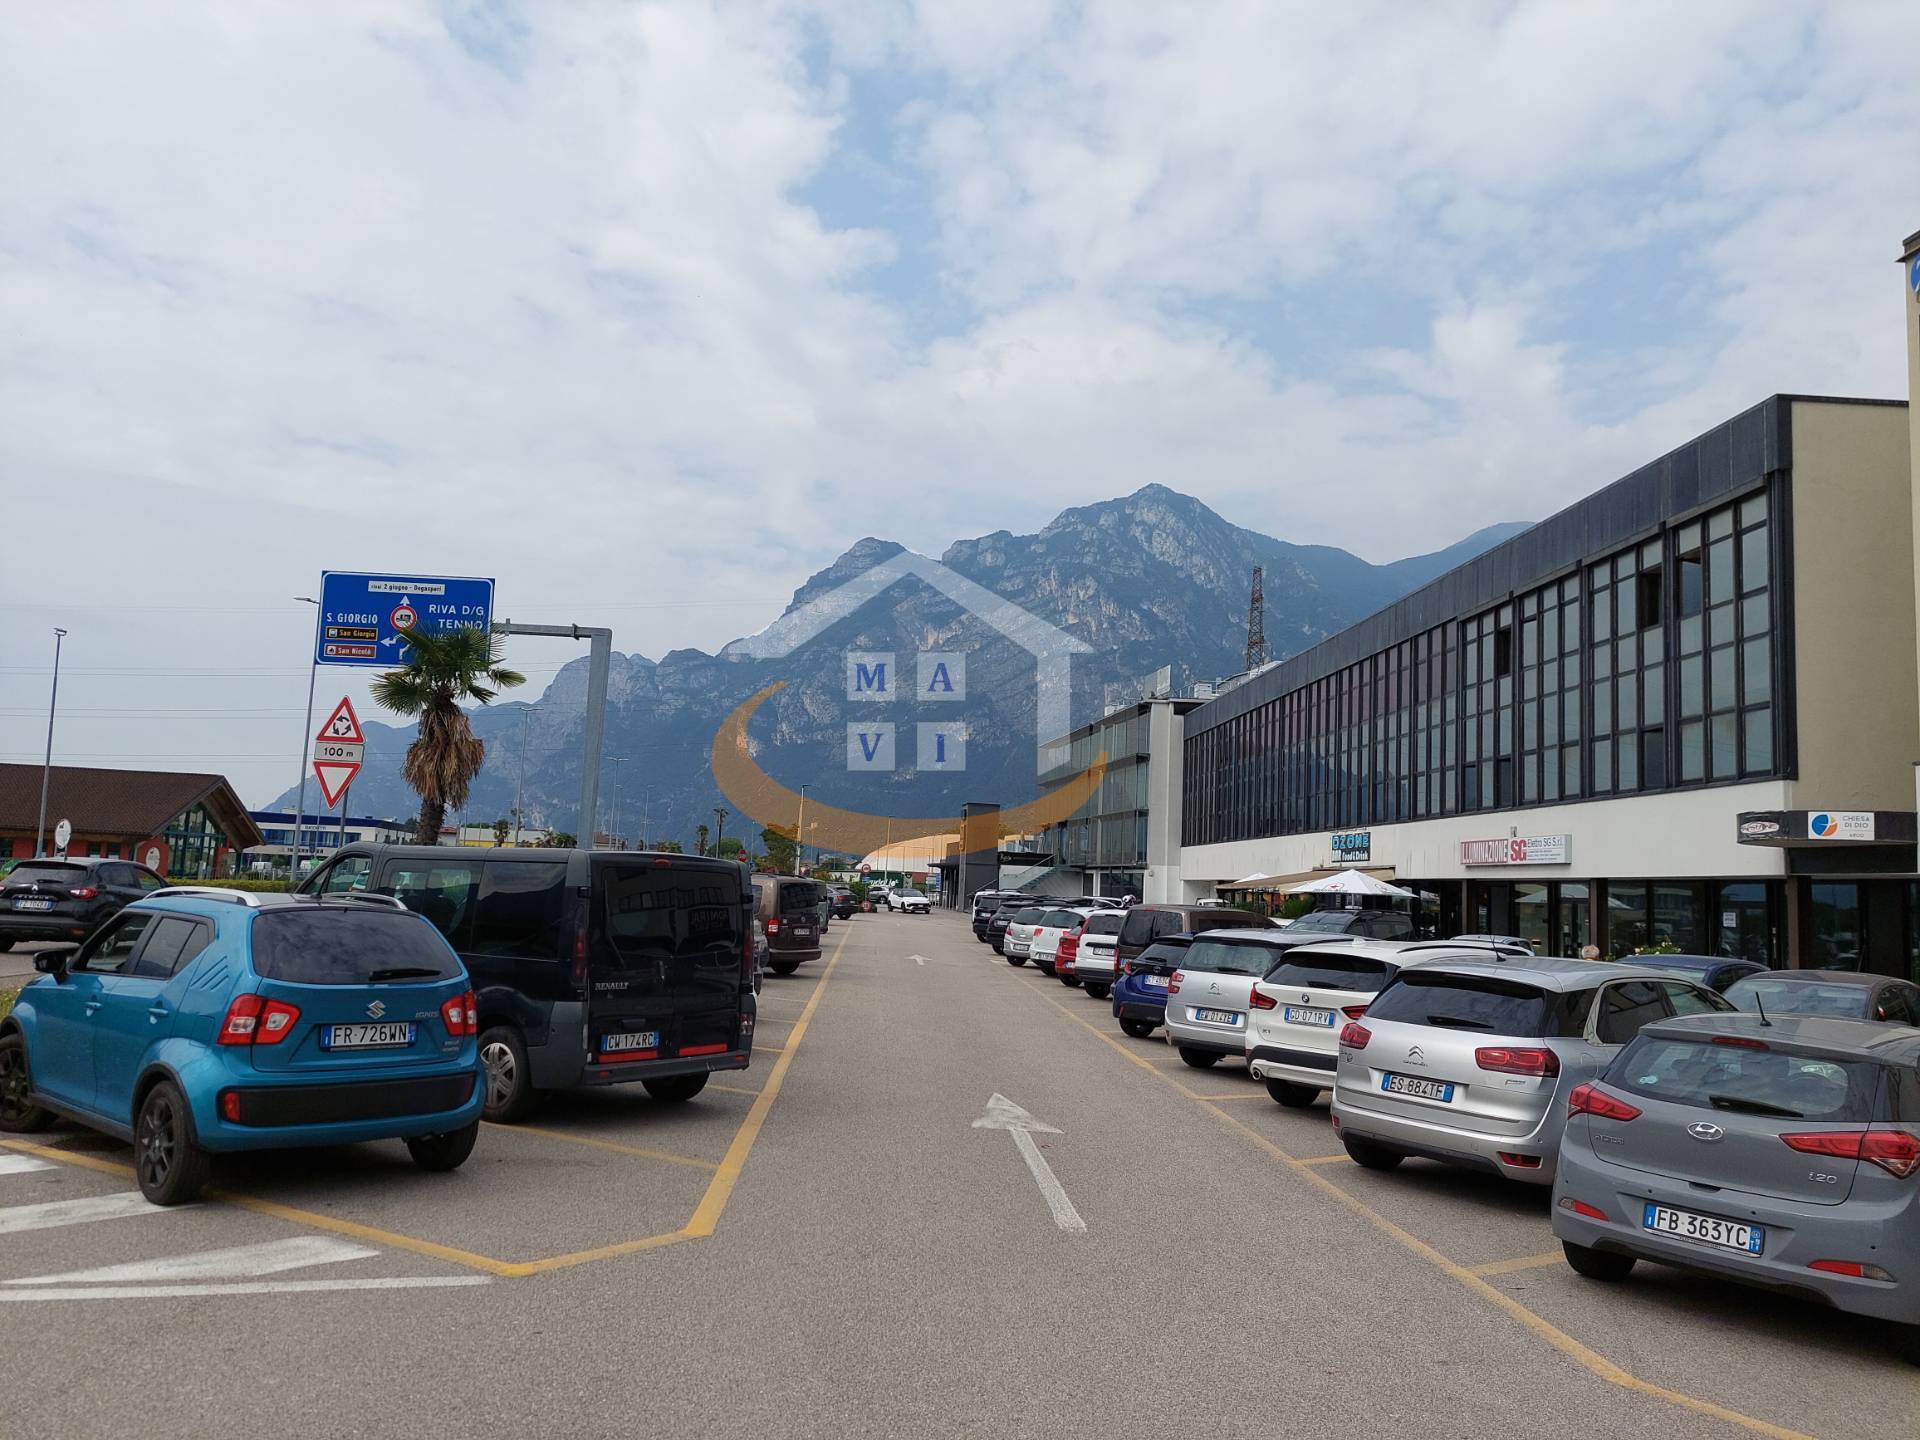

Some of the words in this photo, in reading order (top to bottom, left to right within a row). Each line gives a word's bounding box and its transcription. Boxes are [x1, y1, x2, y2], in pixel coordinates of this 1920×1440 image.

[429, 604, 456, 615] RIVA
[462, 606, 485, 616] D/G
[326, 612, 335, 623] S.
[337, 613, 378, 625] GIORGIO
[438, 619, 484, 630] TENNO
[324, 747, 343, 757] 100
[1332, 832, 1369, 849] OZONE
[1511, 839, 1527, 861] SG
[595, 982, 629, 991] RENAULT
[333, 1027, 353, 1044] FR
[360, 1024, 408, 1043] 726WN
[1390, 1076, 1404, 1092] ES
[1657, 1209, 1679, 1231] FB
[1686, 1215, 1747, 1246] 363YC
